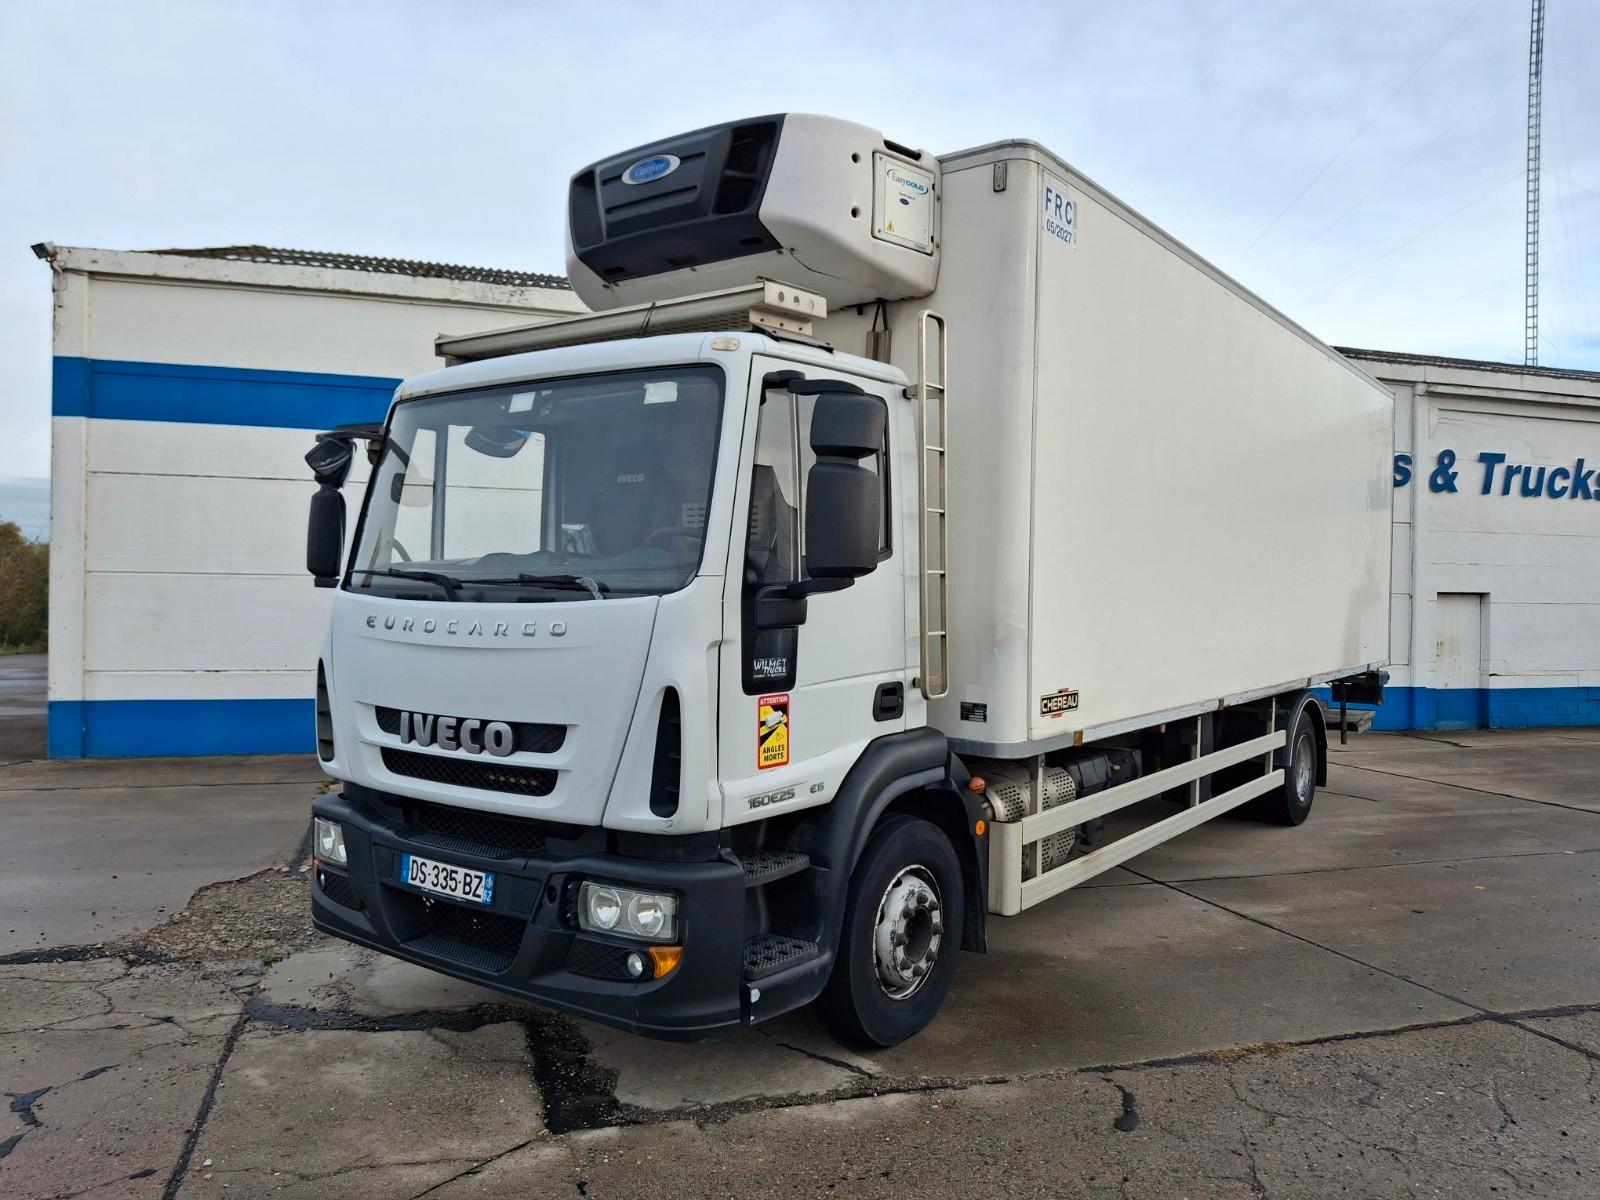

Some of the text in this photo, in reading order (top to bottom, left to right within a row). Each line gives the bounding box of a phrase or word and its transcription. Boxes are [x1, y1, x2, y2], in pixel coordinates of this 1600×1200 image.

[1045, 186, 1073, 225] FRC
[1046, 218, 1072, 244] 05/2027
[1430, 449, 1459, 494] &
[366, 615, 567, 637] EUROCARGO
[753, 657, 787, 671] WILMET
[760, 695, 788, 705] ATTENTION
[1042, 694, 1078, 712] CHEREAU
[400, 711, 514, 757] IVECO
[762, 743, 785, 755] ANGLES
[763, 752, 784, 762] MORTS
[747, 787, 795, 809] 160E25
